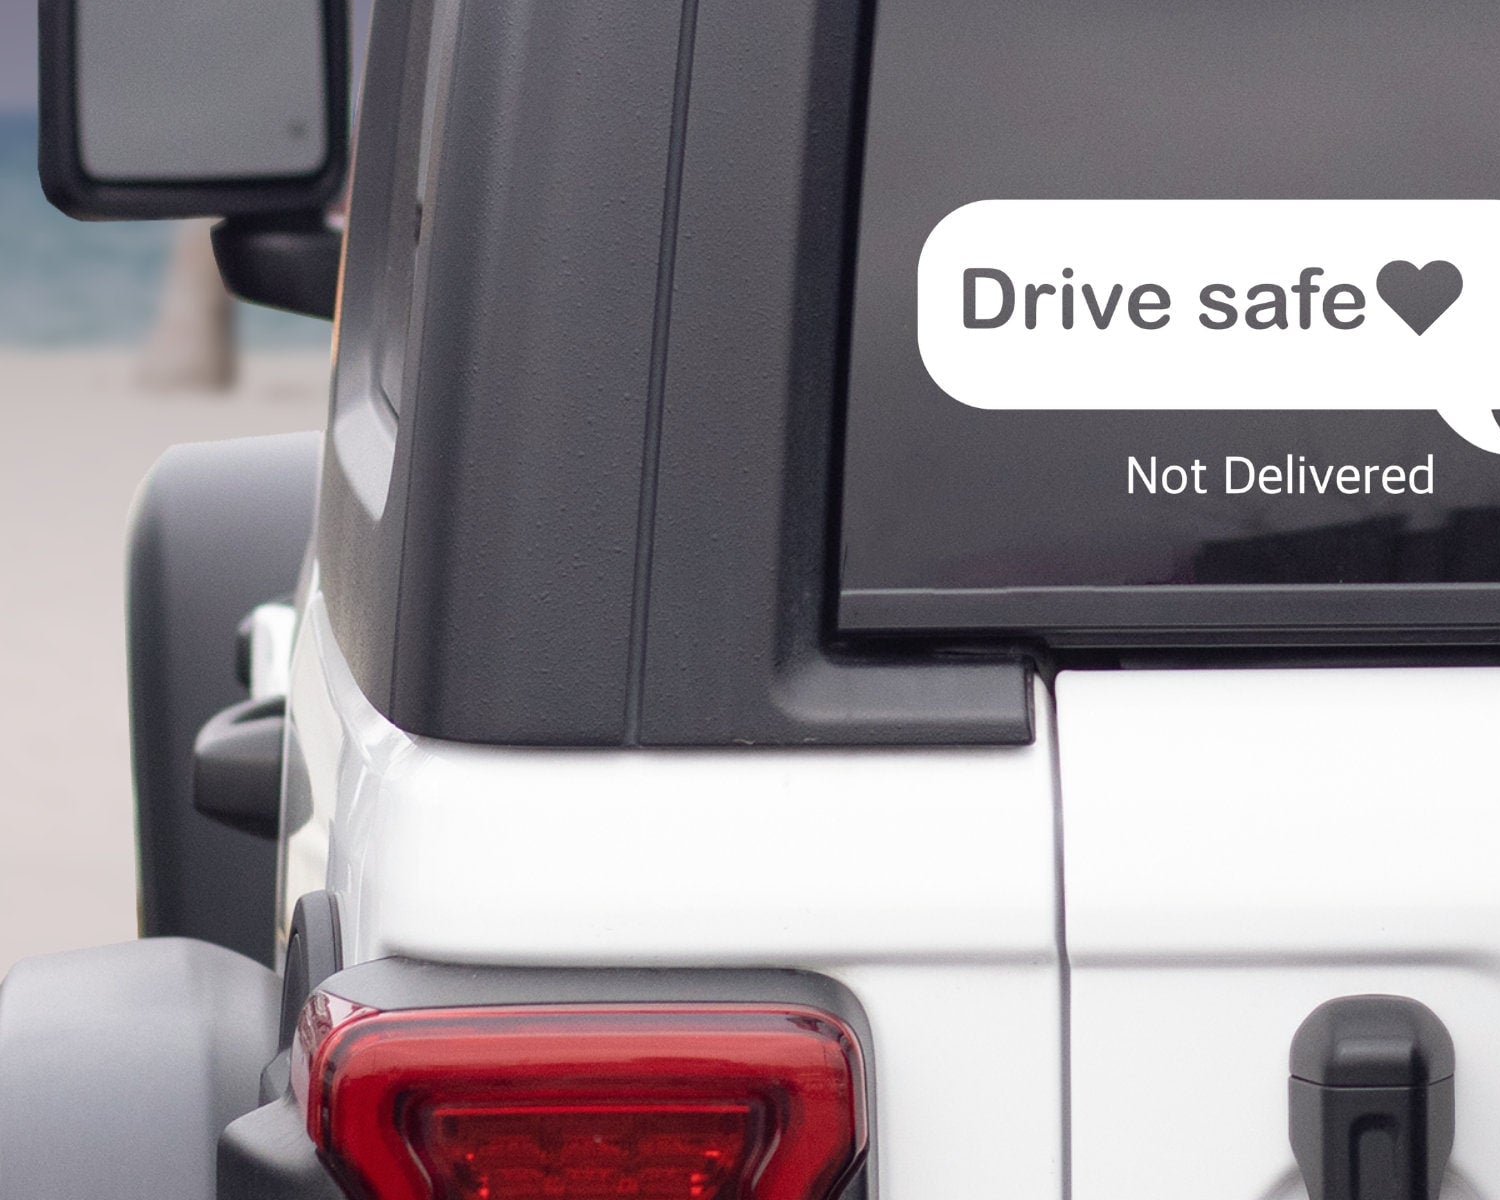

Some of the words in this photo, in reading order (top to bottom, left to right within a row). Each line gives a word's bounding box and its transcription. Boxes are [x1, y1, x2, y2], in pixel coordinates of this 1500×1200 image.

[962, 267, 1171, 331] Drive
[1198, 266, 1366, 331] safe
[1128, 456, 1208, 495] Not
[1225, 453, 1434, 495] Delivered
